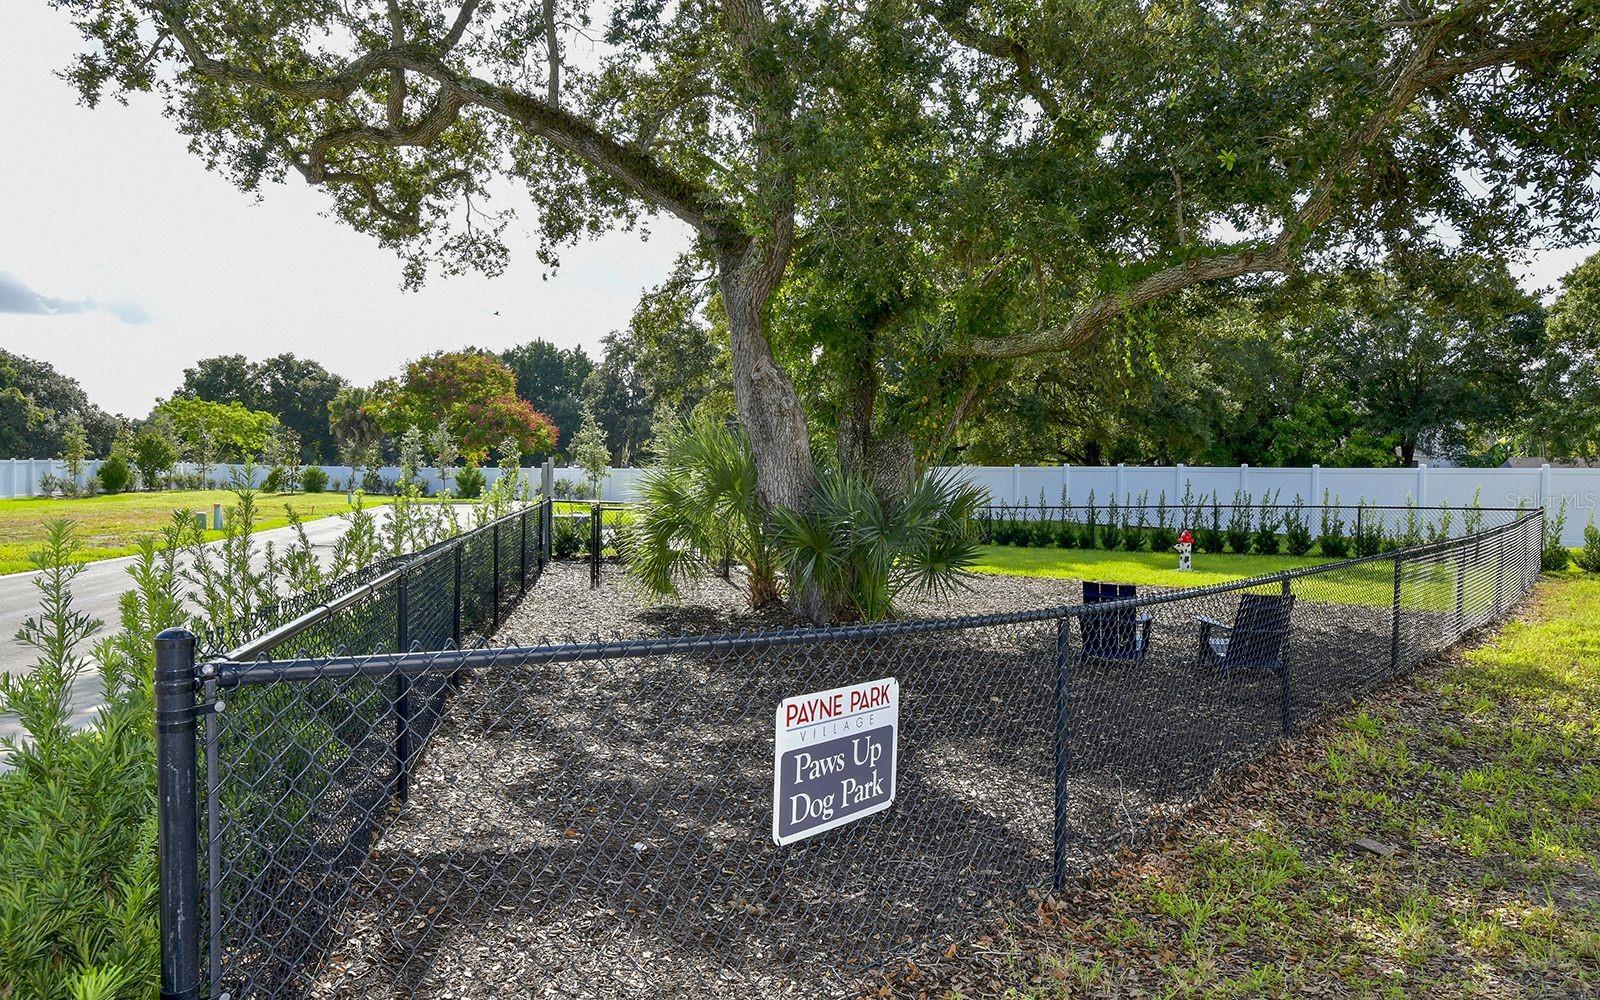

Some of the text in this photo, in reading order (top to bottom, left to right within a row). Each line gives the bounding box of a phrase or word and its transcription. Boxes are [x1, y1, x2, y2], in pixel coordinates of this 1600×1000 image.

[786, 684, 890, 727] PAYNE PARK
[800, 714, 874, 741] VILLAGE
[793, 735, 882, 785] Paws Up
[789, 769, 884, 826] Dog Park
